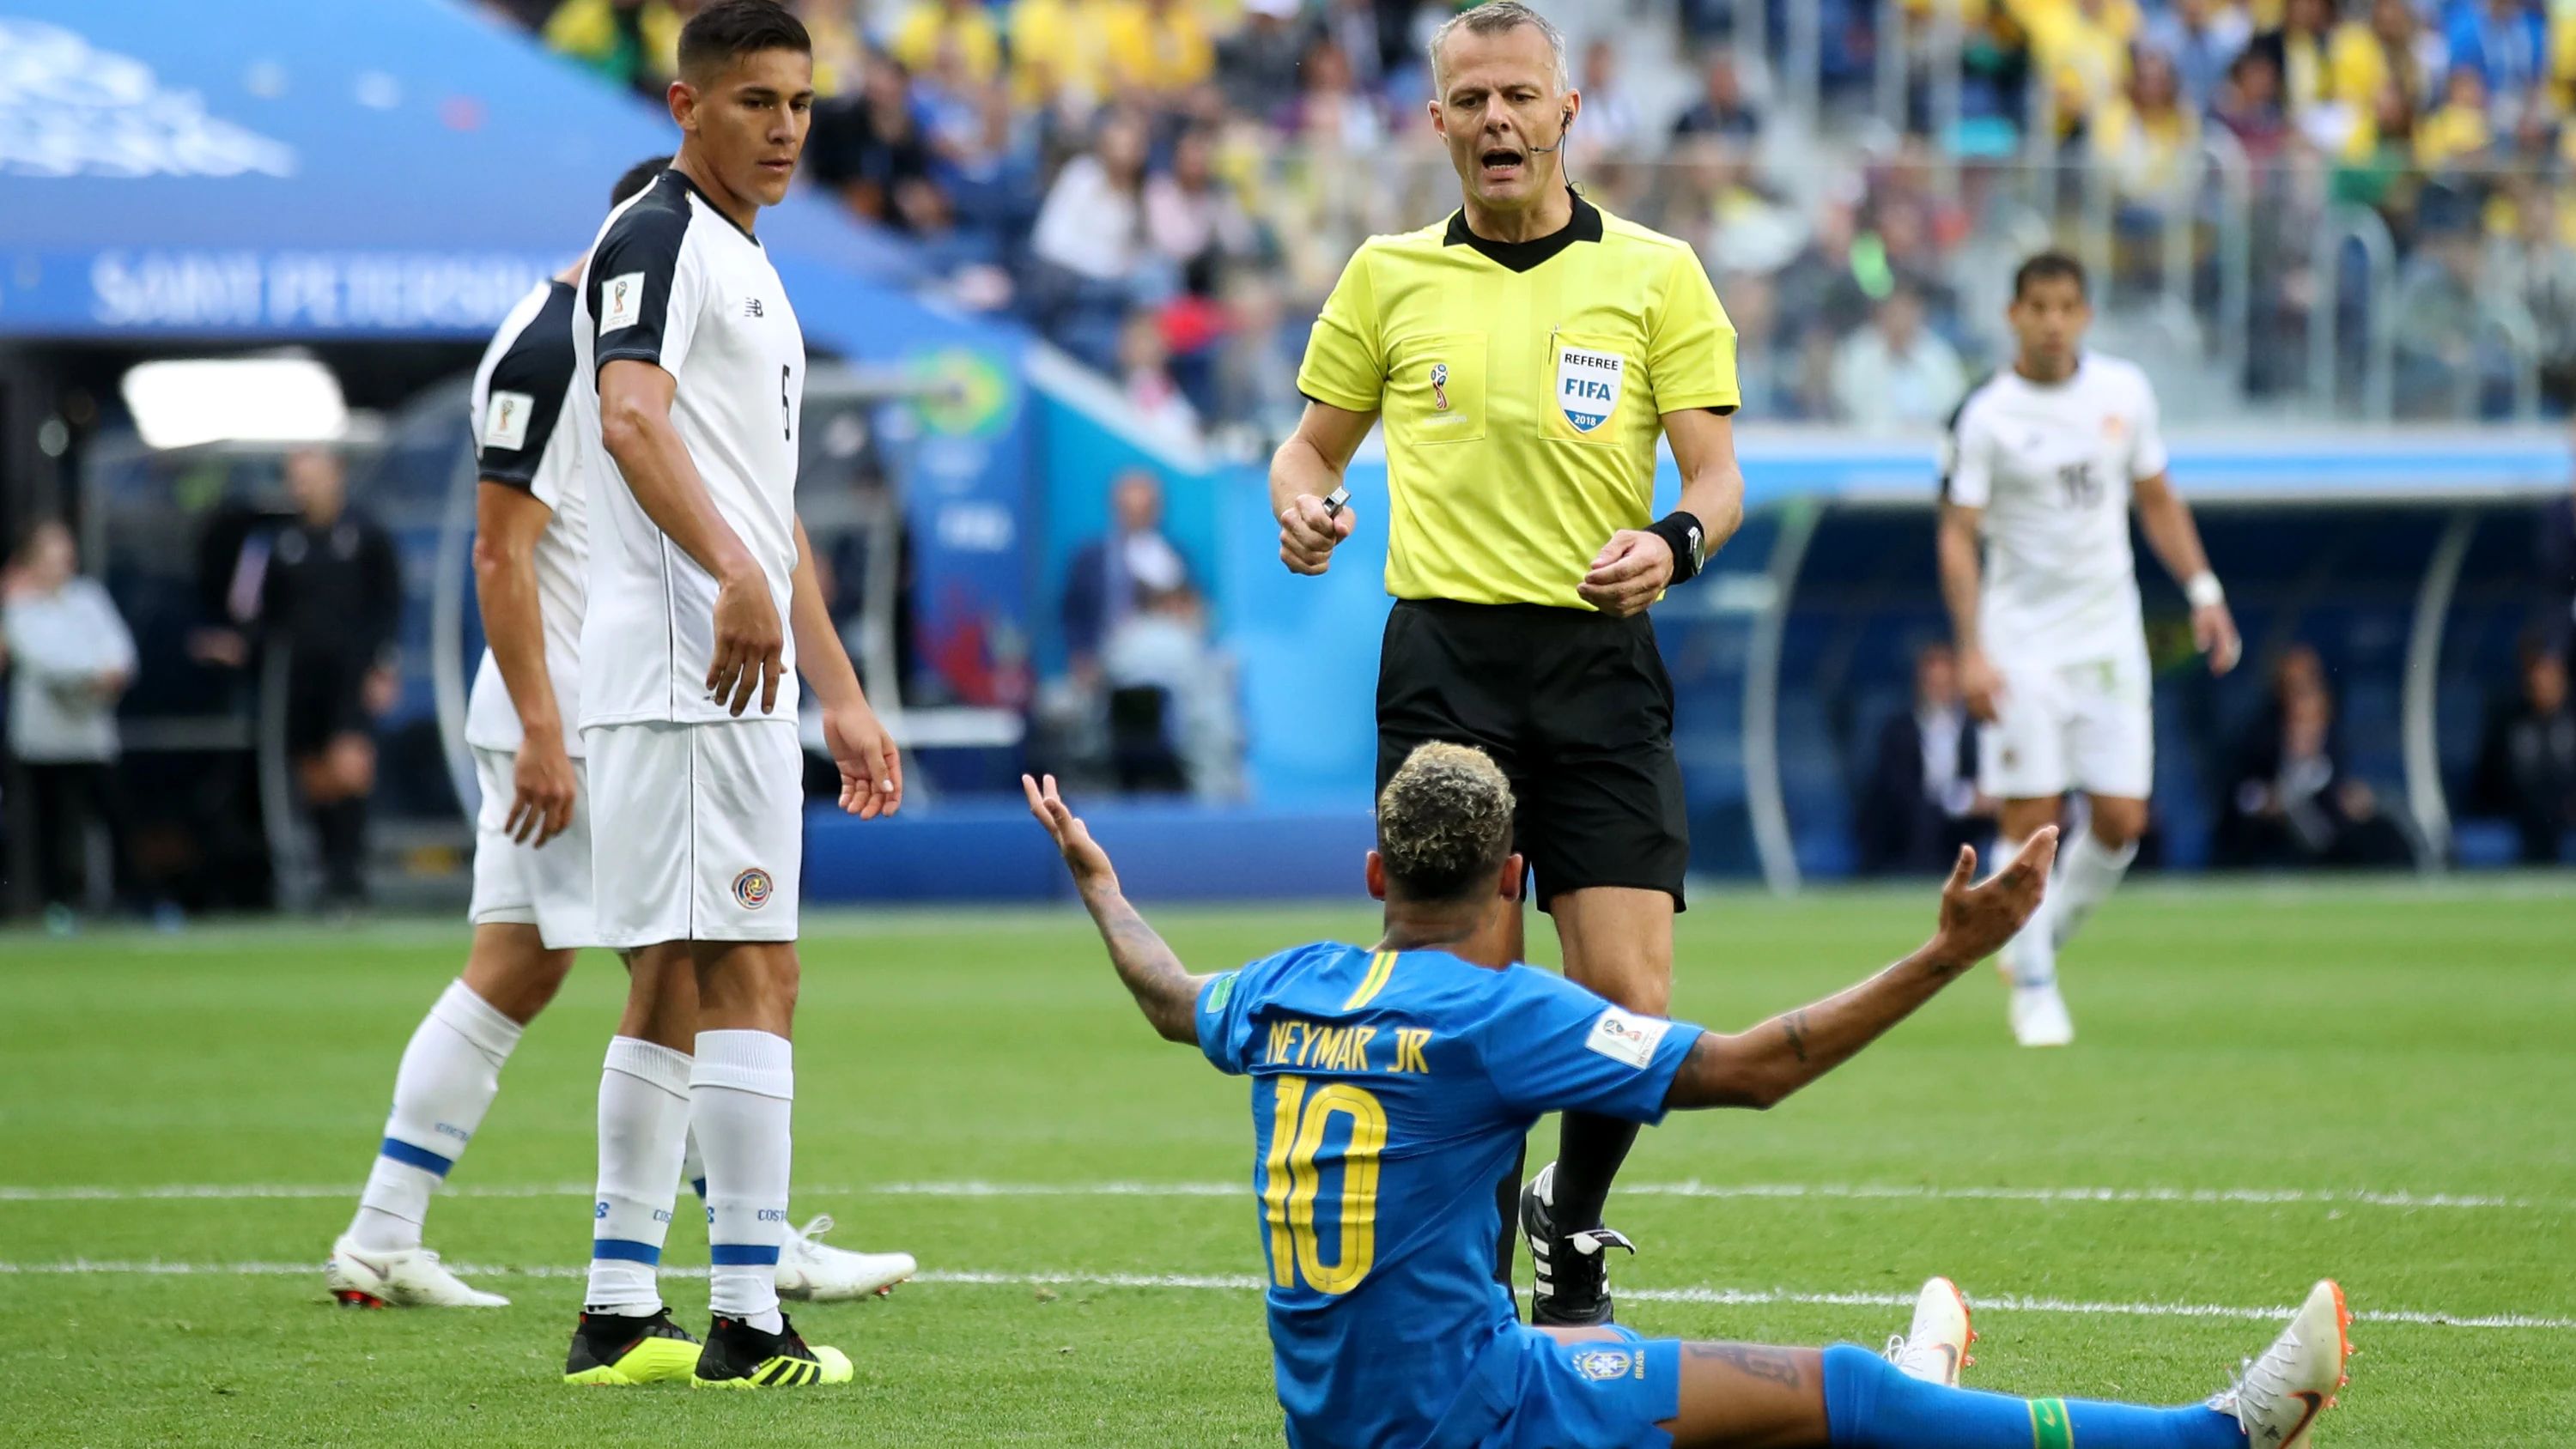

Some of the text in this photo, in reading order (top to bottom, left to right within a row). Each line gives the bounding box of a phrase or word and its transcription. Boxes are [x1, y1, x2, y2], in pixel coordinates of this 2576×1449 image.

[1564, 353, 1619, 371] REFEREE
[782, 364, 790, 442] 5
[1564, 378, 1611, 401] FIFA
[1574, 415, 1596, 426] 2018
[1266, 1021, 1433, 1074] NEYMAR JR
[1265, 1074, 1388, 1294] 10
